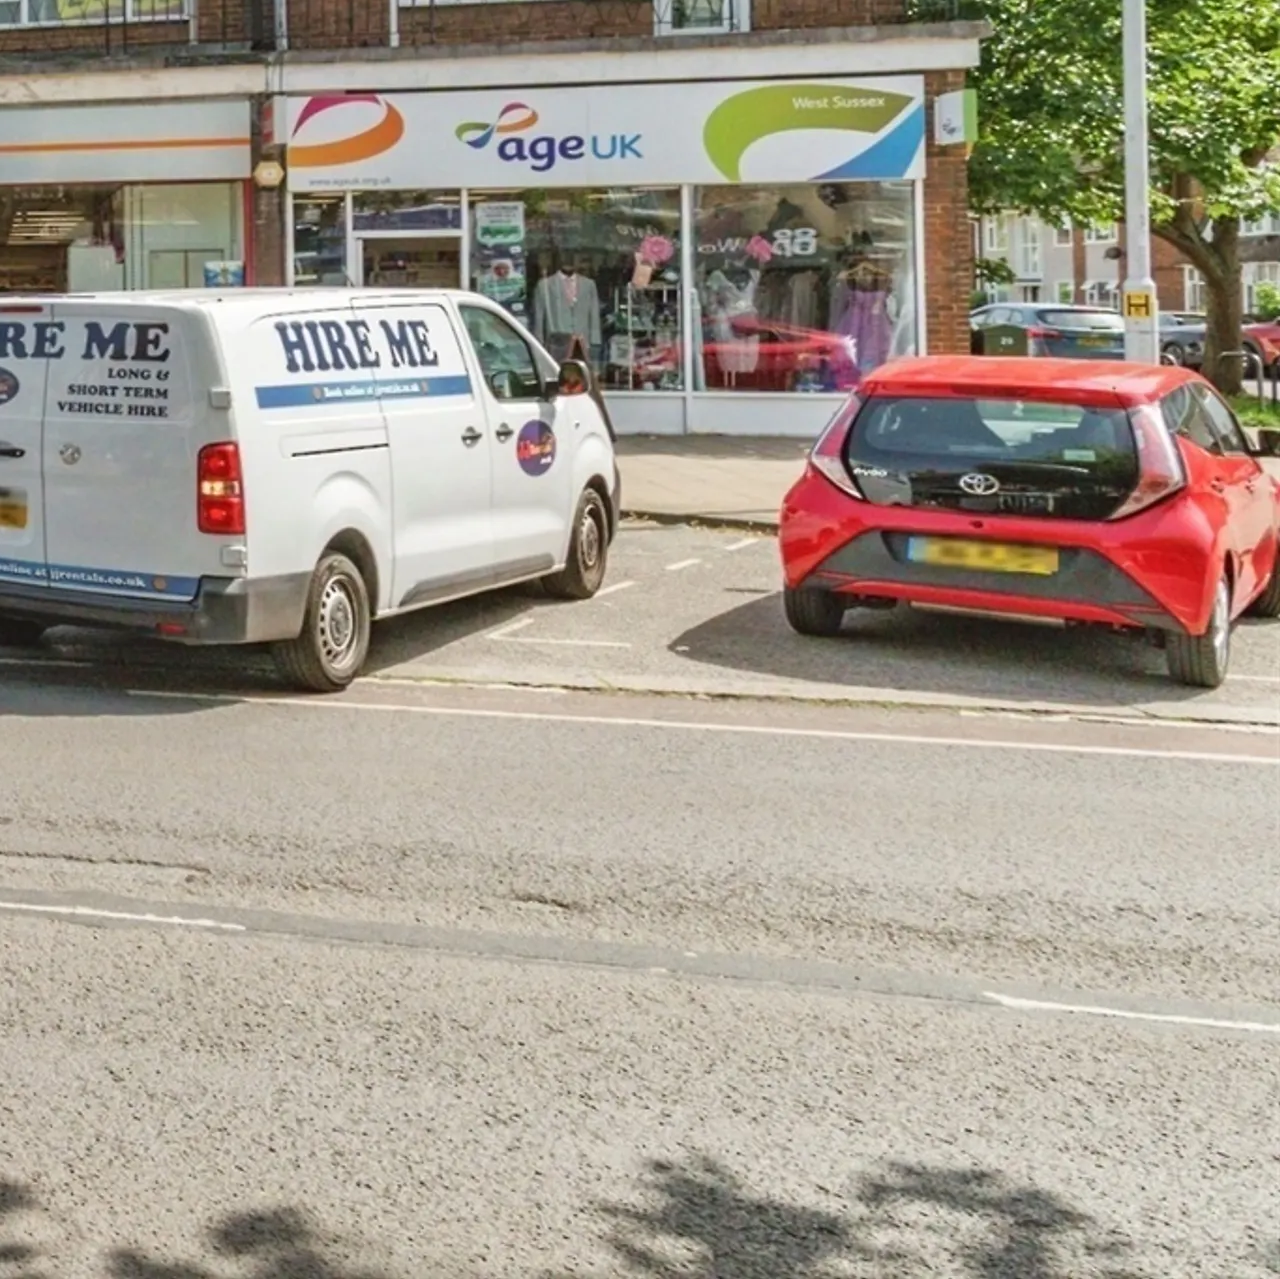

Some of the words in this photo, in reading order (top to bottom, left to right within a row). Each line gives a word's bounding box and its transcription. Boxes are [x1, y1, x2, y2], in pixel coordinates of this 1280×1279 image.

[792, 97, 829, 109] West
[832, 96, 885, 109] Sussex
[497, 135, 585, 171] age
[591, 134, 643, 159] UK
[1127, 293, 1149, 317] H
[81, 322, 171, 362] ME
[274, 319, 381, 373] HIRE
[379, 319, 439, 368] ME
[108, 368, 151, 380] LONG
[156, 371, 170, 380] &
[67, 384, 117, 397] SHORT
[123, 387, 169, 399] TERM
[57, 401, 123, 415] VEHICLE
[128, 404, 169, 418] HIRE
[35, 567, 47, 577] at
[50, 568, 146, 588] jjrentals.co.uk
